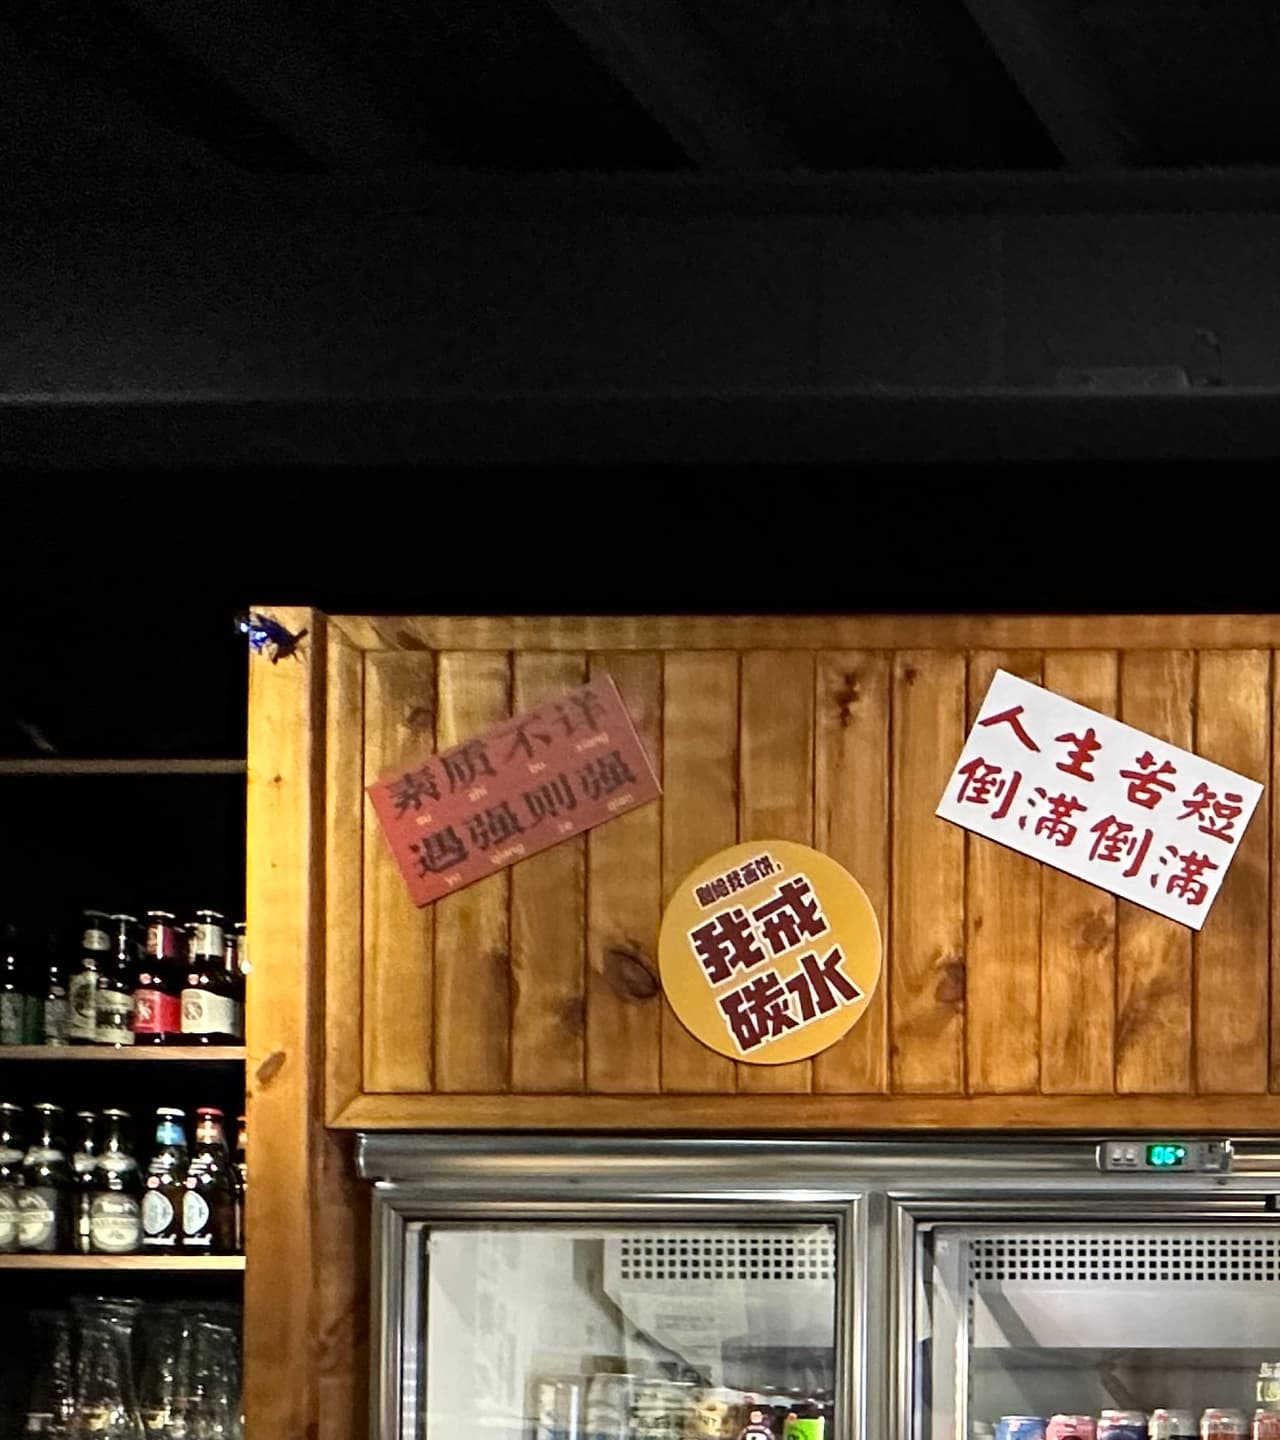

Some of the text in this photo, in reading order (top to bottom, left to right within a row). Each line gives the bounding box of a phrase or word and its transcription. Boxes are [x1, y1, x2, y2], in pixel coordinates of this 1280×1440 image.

[978, 705, 1243, 845] 人生苦短
[693, 877, 828, 983] 我戒
[719, 948, 861, 1052] 碳水
